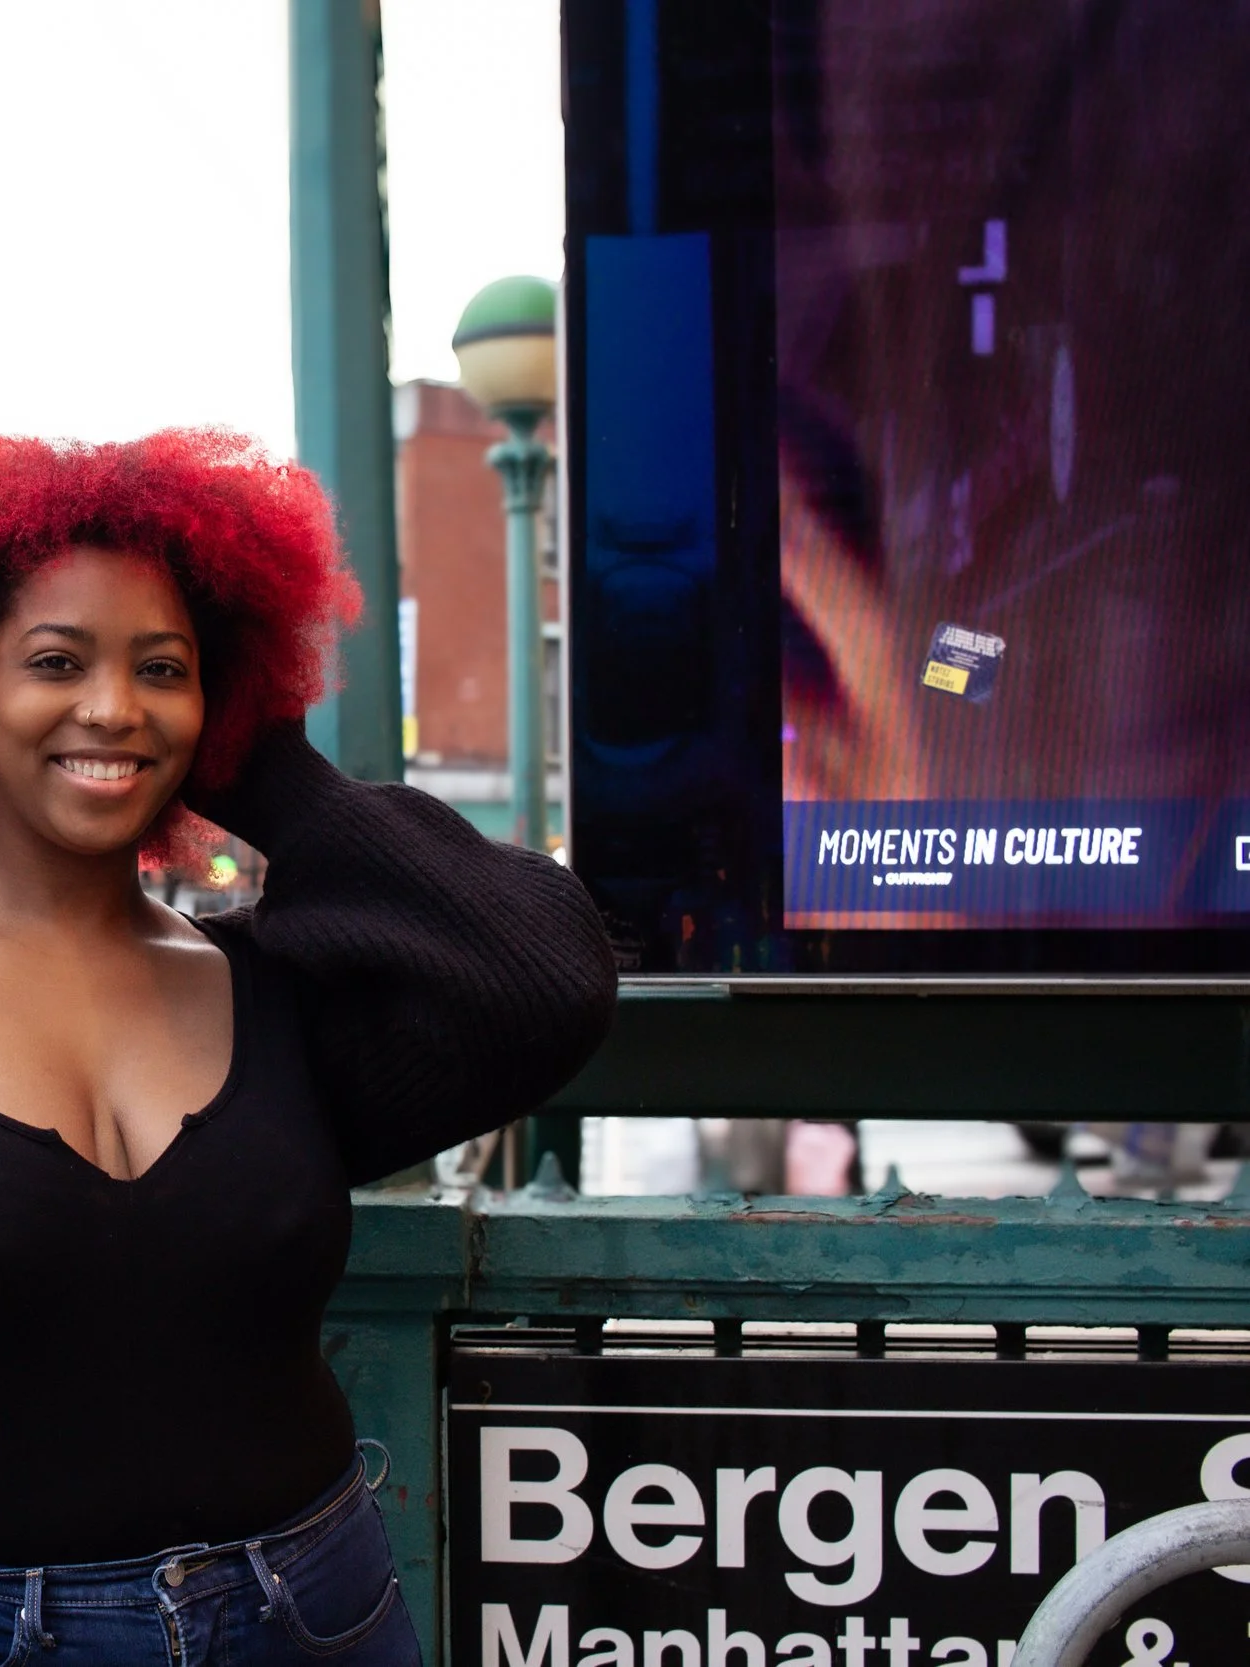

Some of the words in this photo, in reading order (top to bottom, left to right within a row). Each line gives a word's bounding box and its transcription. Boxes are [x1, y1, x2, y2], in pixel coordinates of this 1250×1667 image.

[818, 829, 957, 865] MOMENTS
[963, 828, 997, 865] IN
[1003, 828, 1143, 865] CULTURE
[481, 1427, 1105, 1606] Bergen
[481, 1603, 1018, 1667] Manhatta
